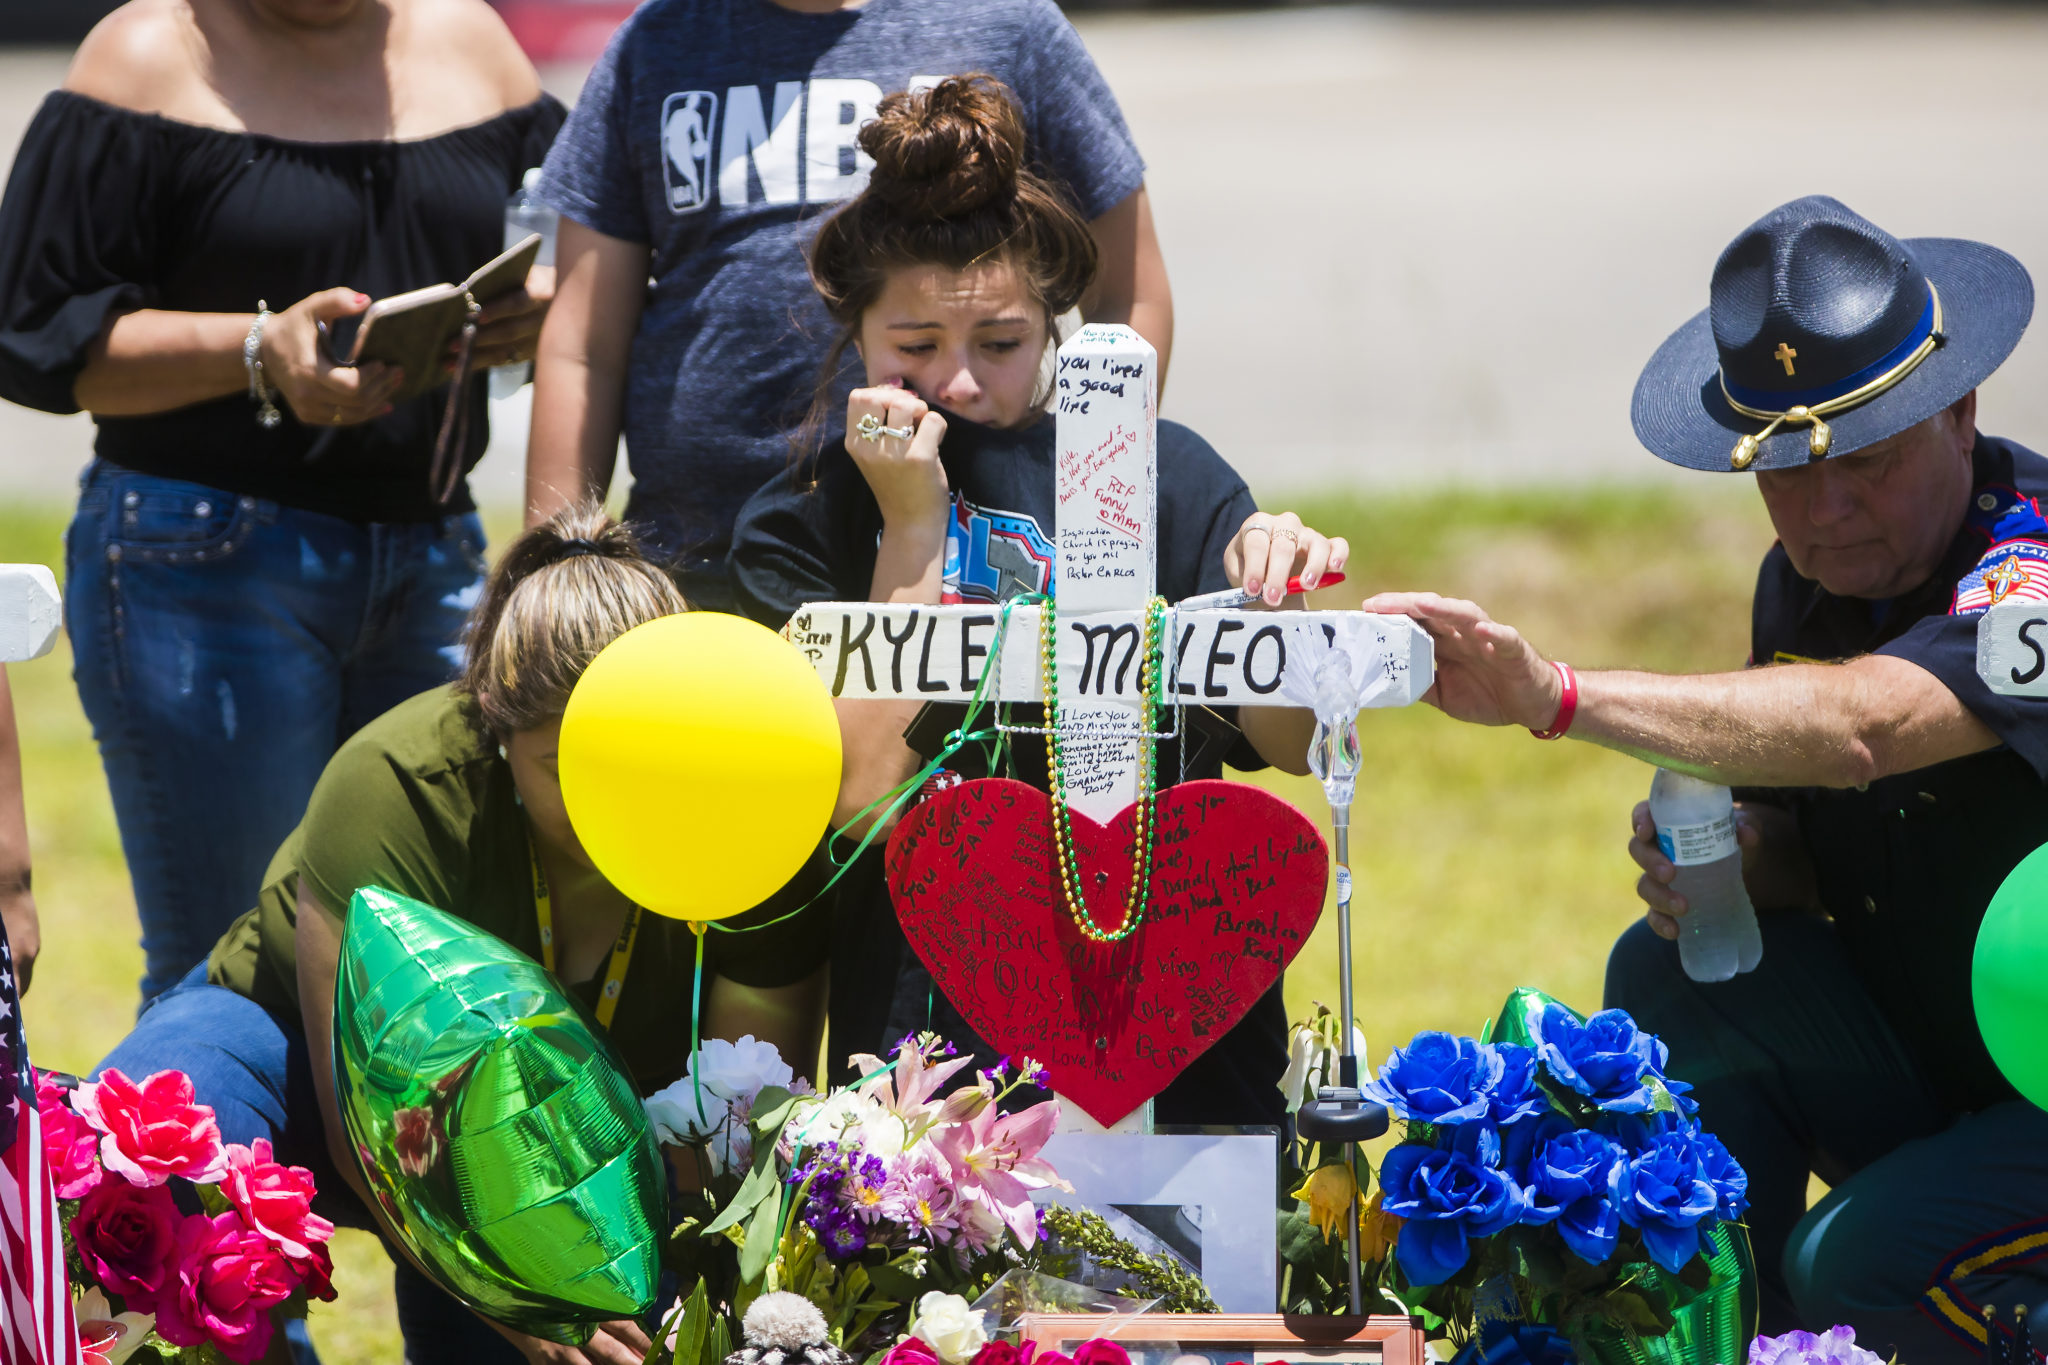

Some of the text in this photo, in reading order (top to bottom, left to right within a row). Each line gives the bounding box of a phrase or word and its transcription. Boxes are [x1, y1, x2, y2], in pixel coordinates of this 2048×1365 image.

[718, 74, 955, 206] NB
[1059, 378, 1125, 398] a good
[1108, 475, 1136, 498] RIP
[1978, 546, 2048, 566] HAPLAI
[832, 609, 1337, 698] KYLE MLEO
[1059, 708, 1067, 722] I
